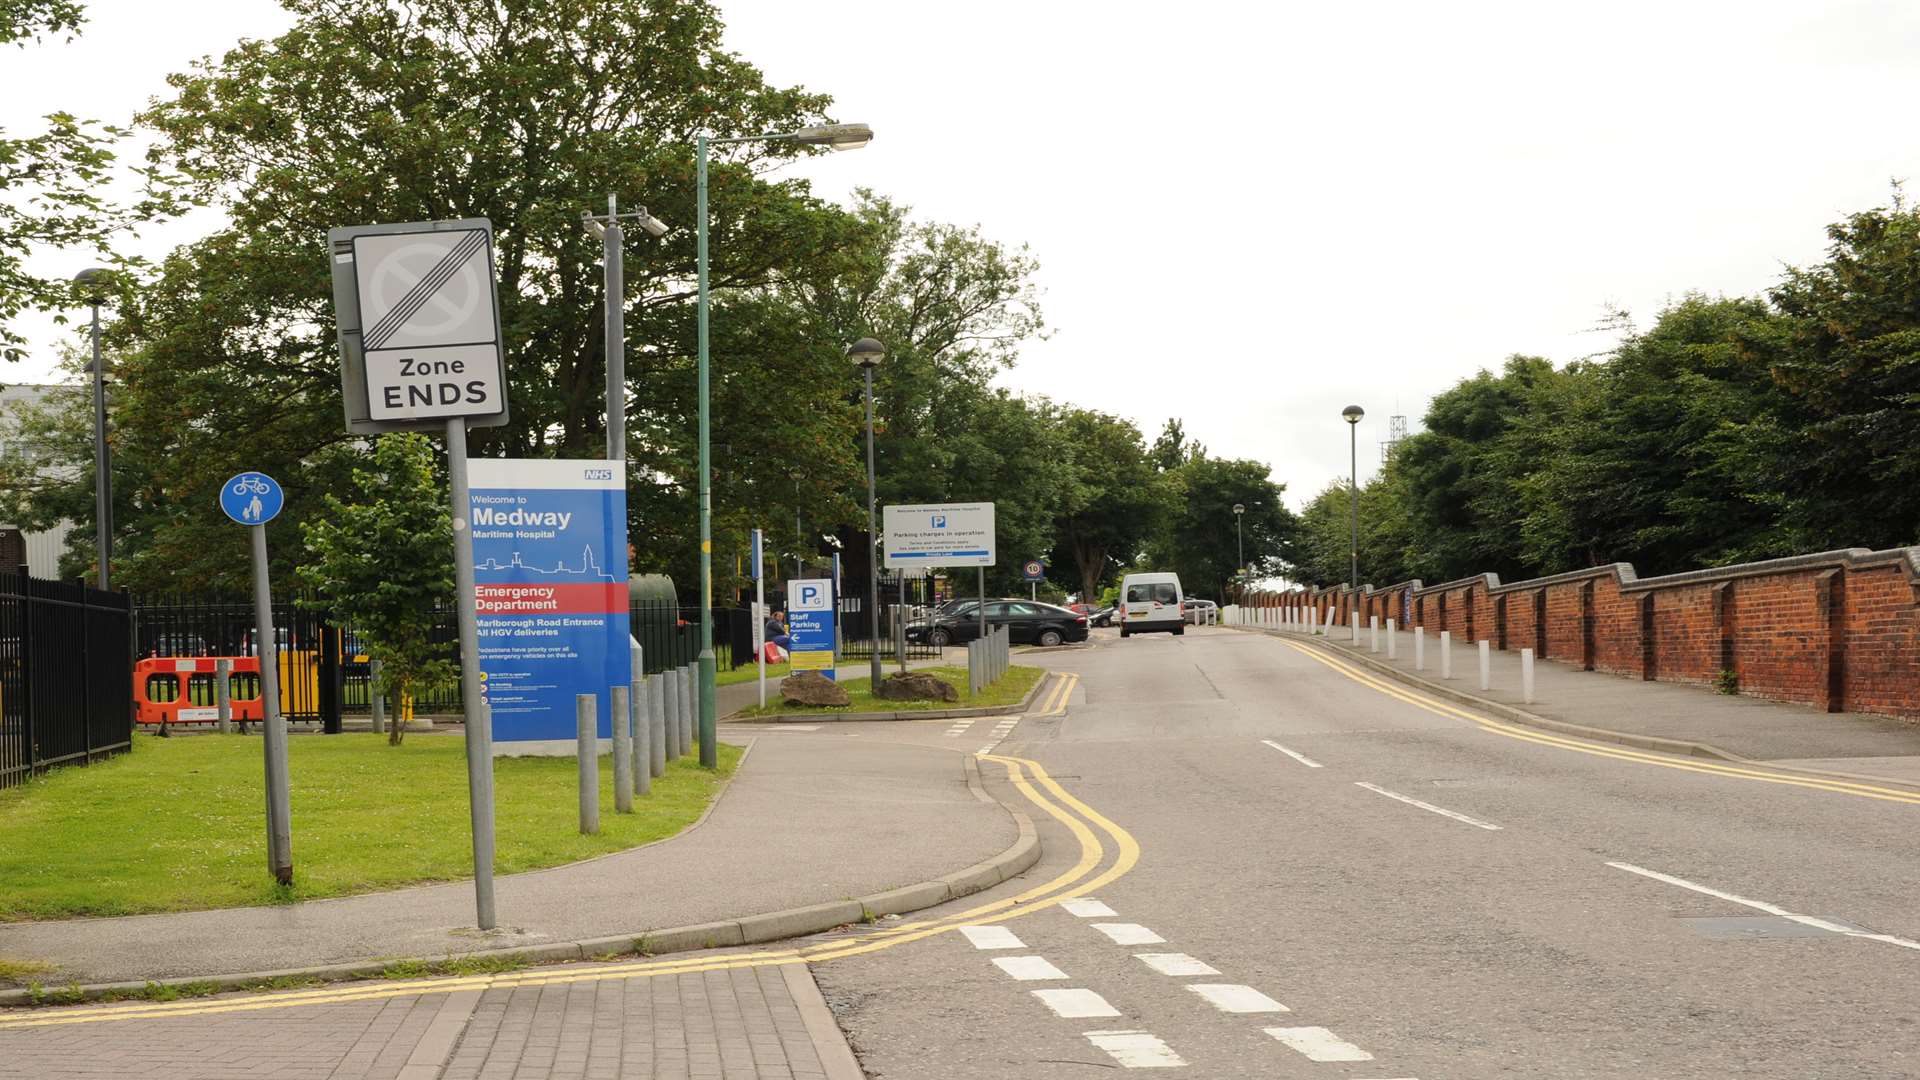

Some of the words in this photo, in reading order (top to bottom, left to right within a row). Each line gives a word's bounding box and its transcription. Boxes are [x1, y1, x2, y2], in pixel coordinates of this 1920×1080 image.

[399, 358, 465, 376] Zone
[383, 381, 487, 408] ENDS
[585, 470, 611, 480] NHS
[471, 496, 515, 504] Welcome
[517, 496, 527, 504] to
[473, 508, 572, 530] Medway
[473, 530, 513, 539] Maritime
[516, 530, 555, 540] Hospital
[475, 586, 555, 599] Emergency
[802, 587, 817, 604] P
[475, 599, 558, 612] Department
[790, 613, 809, 621] Staff
[536, 618, 561, 627] Road
[563, 618, 604, 627] Entrance
[790, 621, 820, 629] Parking
[476, 629, 489, 637] All
[490, 628, 512, 637] HGV
[514, 628, 559, 637] deliveries
